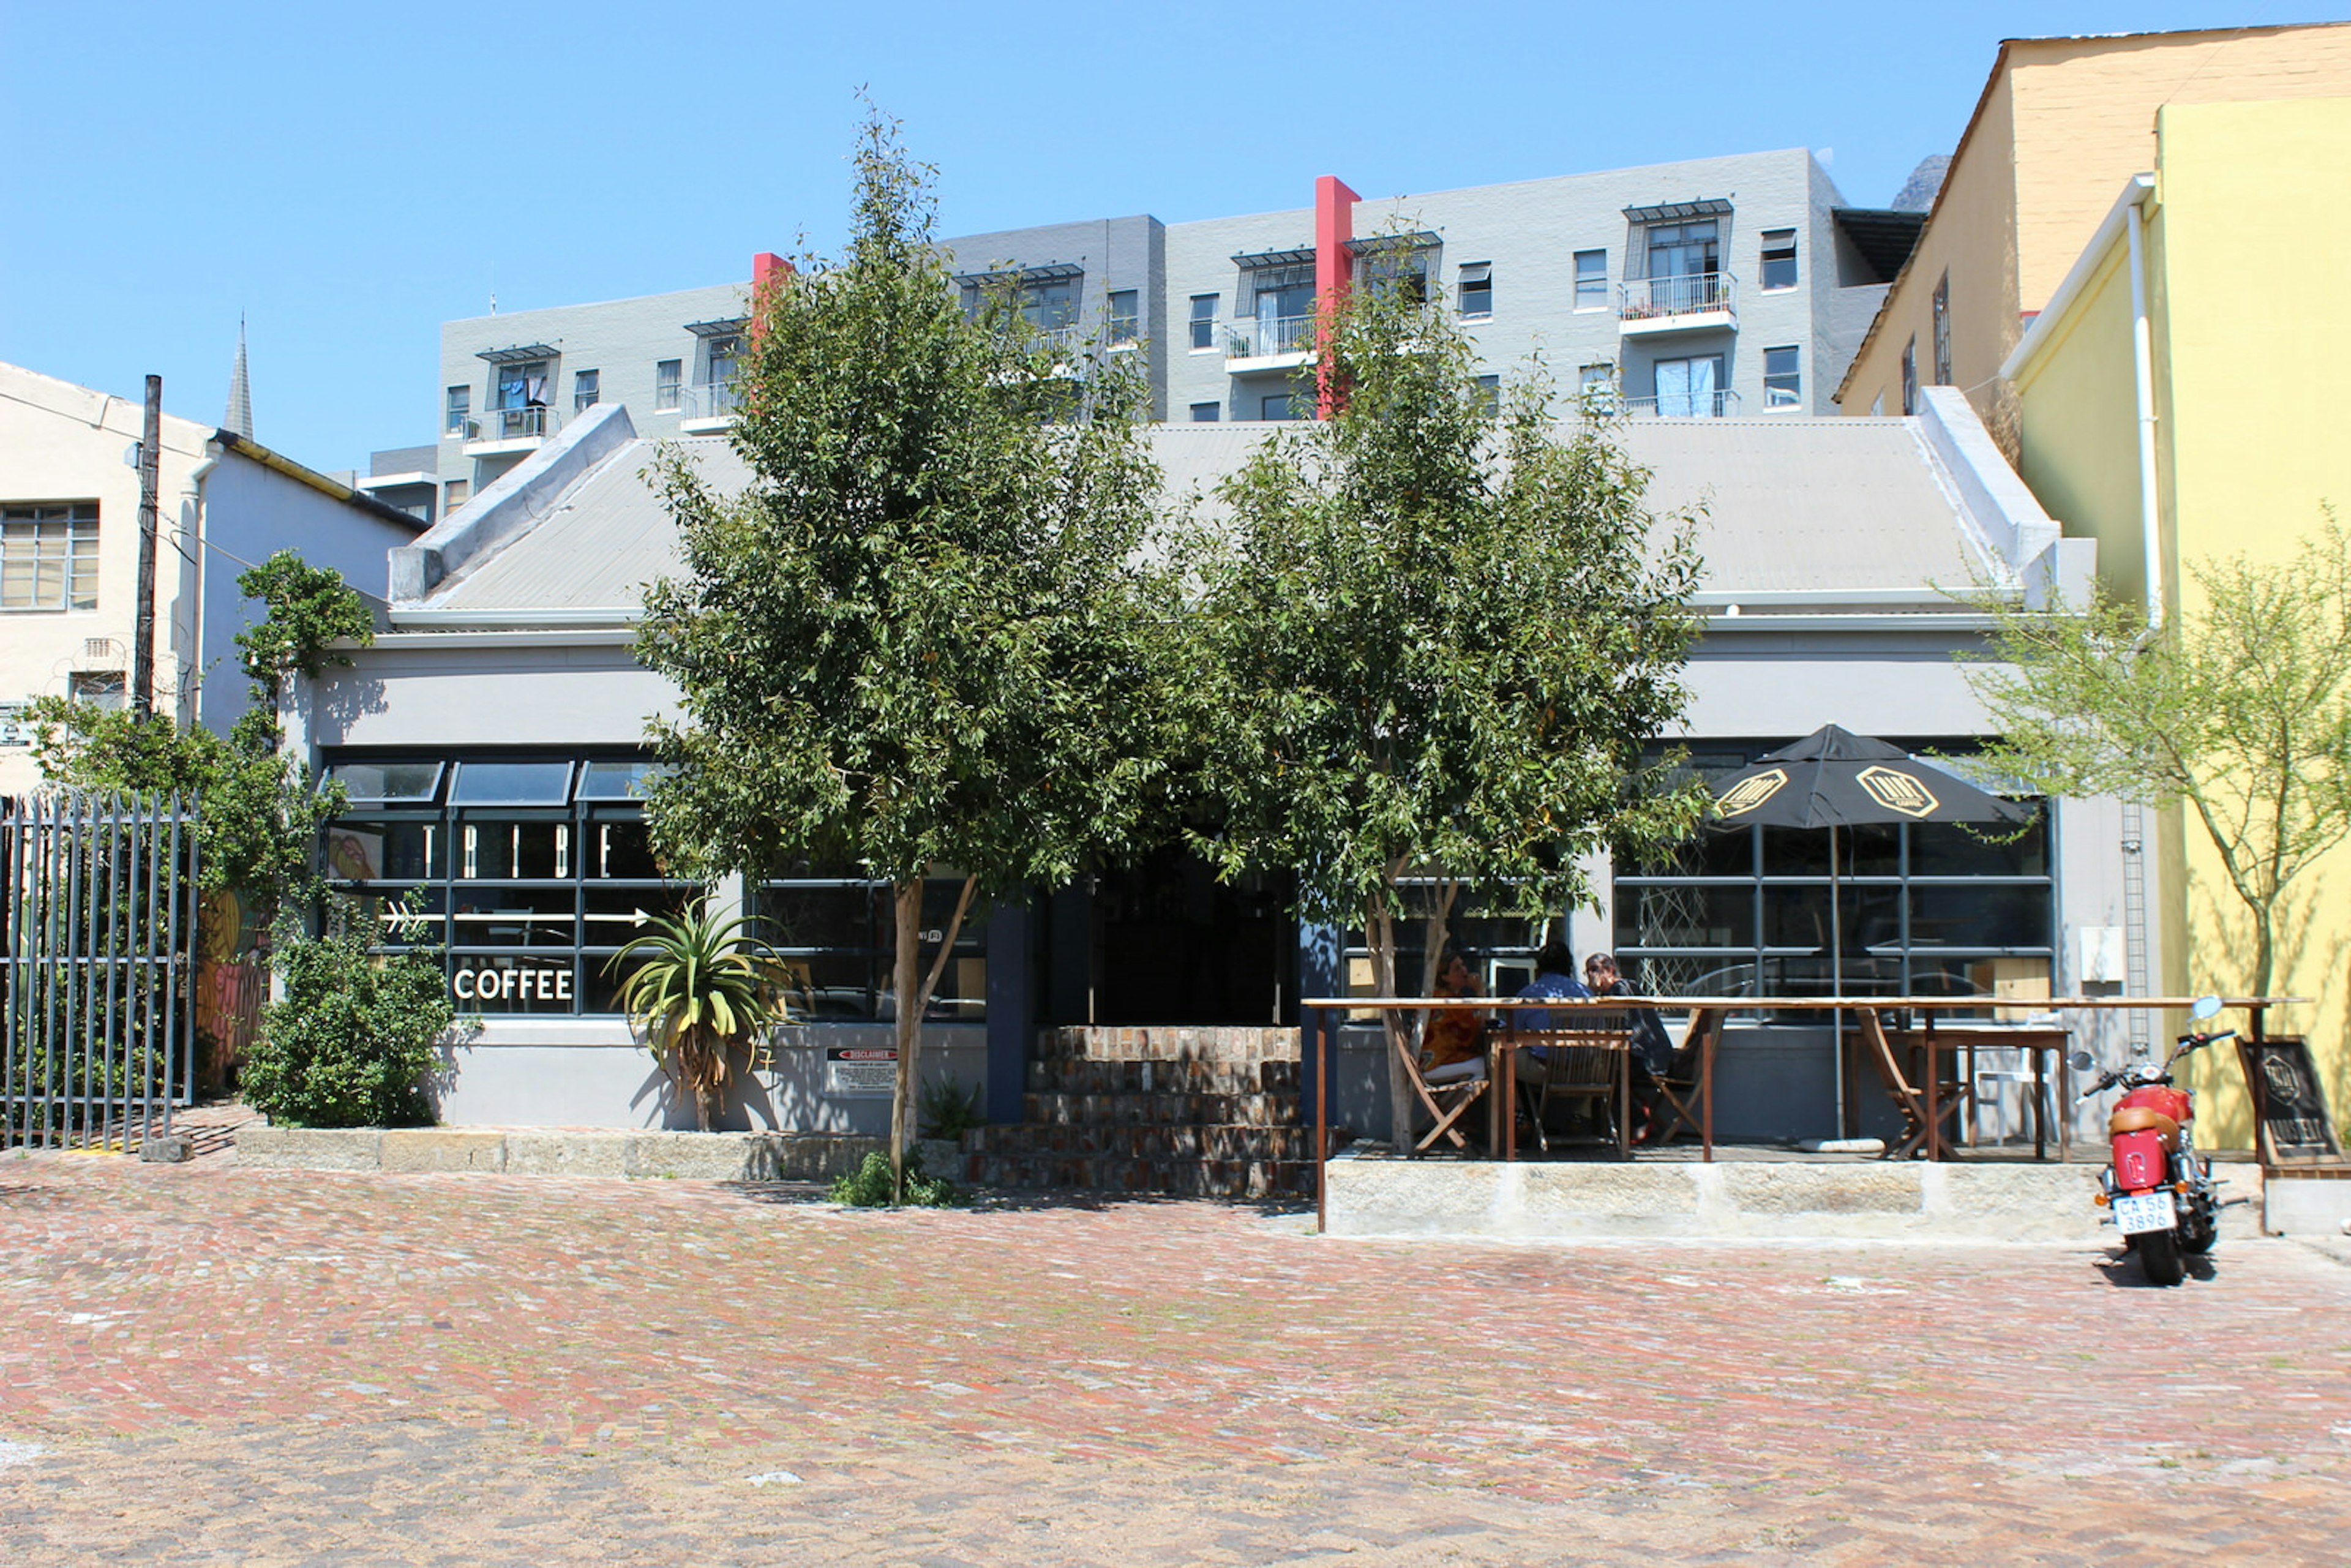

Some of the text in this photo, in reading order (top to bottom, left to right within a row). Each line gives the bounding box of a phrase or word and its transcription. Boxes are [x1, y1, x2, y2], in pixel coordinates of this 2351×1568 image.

[422, 824, 611, 879] TRIBE
[454, 969, 573, 1000] COFFEE
[849, 1049, 888, 1059] DISCLAIMER
[2120, 1196, 2166, 1215] CA 56
[2126, 1212, 2166, 1231] 3896
